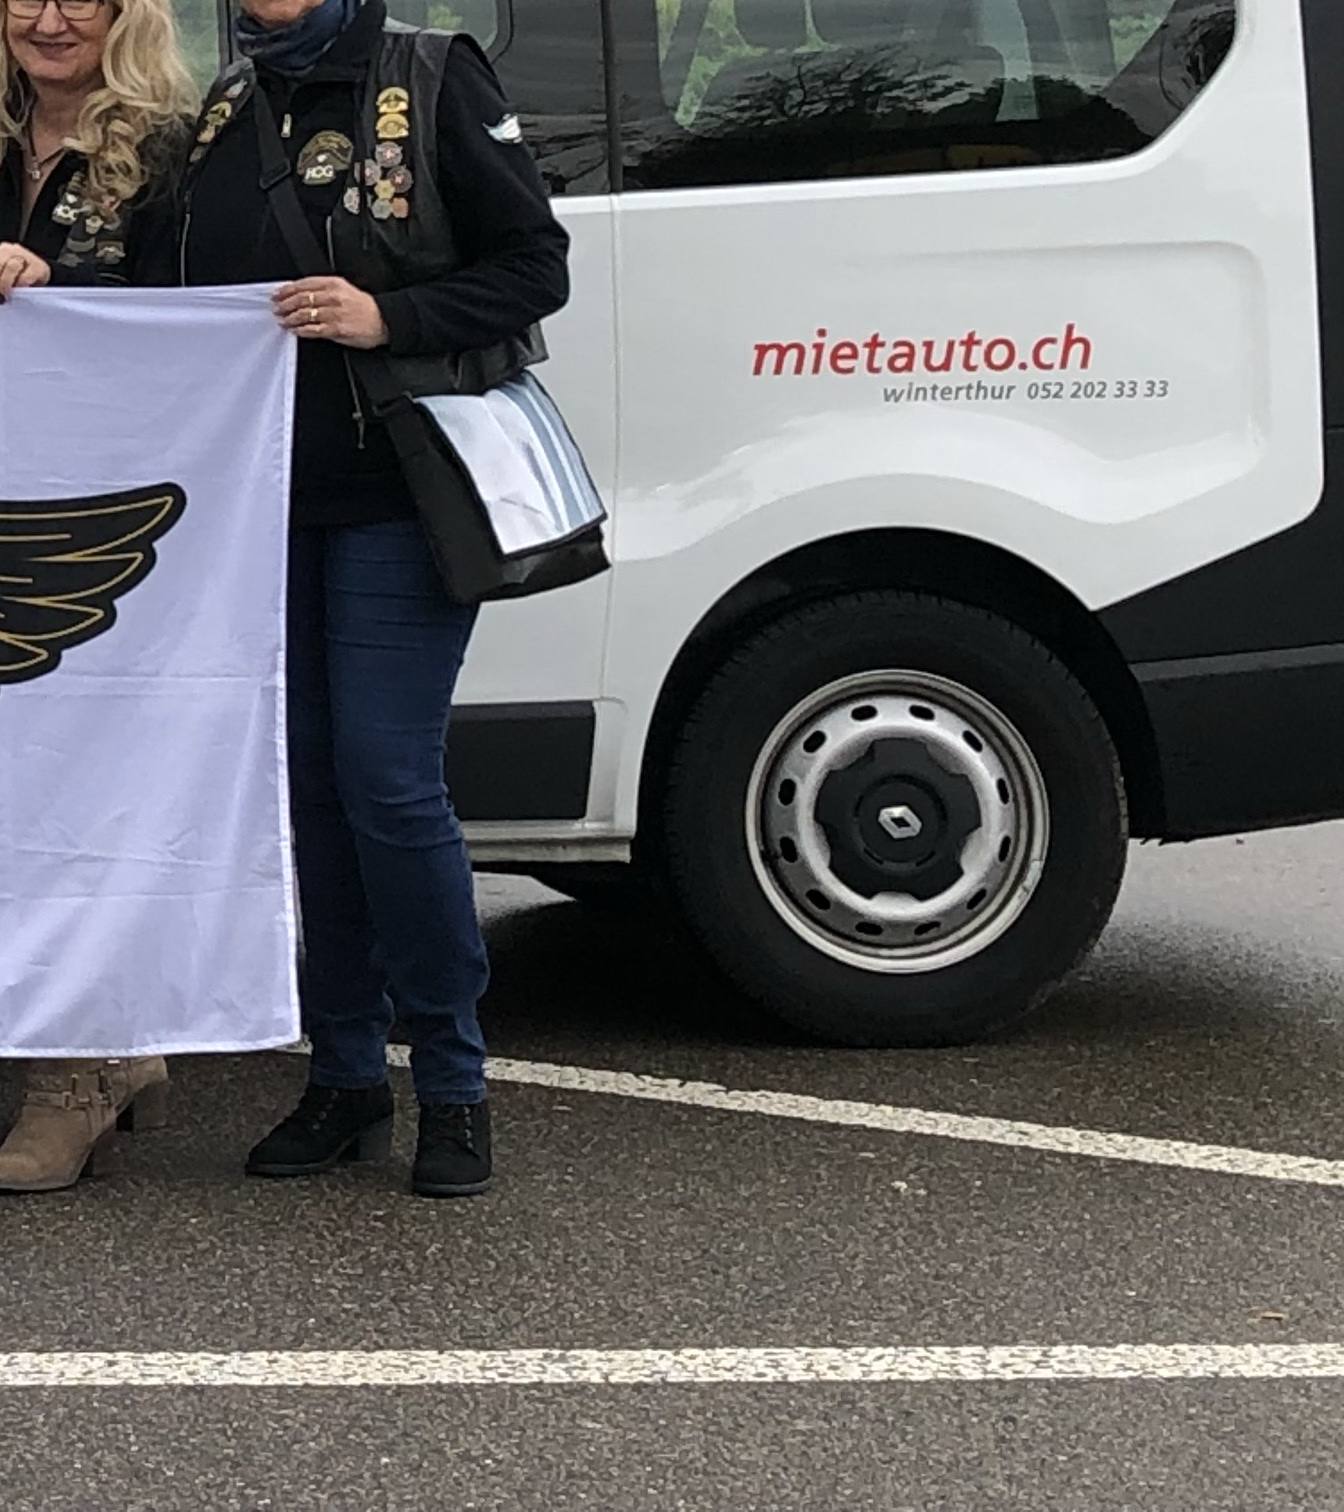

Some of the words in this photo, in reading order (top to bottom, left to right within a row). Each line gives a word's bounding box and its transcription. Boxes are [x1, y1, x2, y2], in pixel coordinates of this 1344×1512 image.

[752, 323, 1092, 376] mietauto.ch
[883, 381, 1016, 403] winterthur
[1027, 382, 1064, 400] 052
[1070, 381, 1108, 399] 202
[1113, 381, 1139, 399] 33
[1143, 380, 1169, 398] 33
